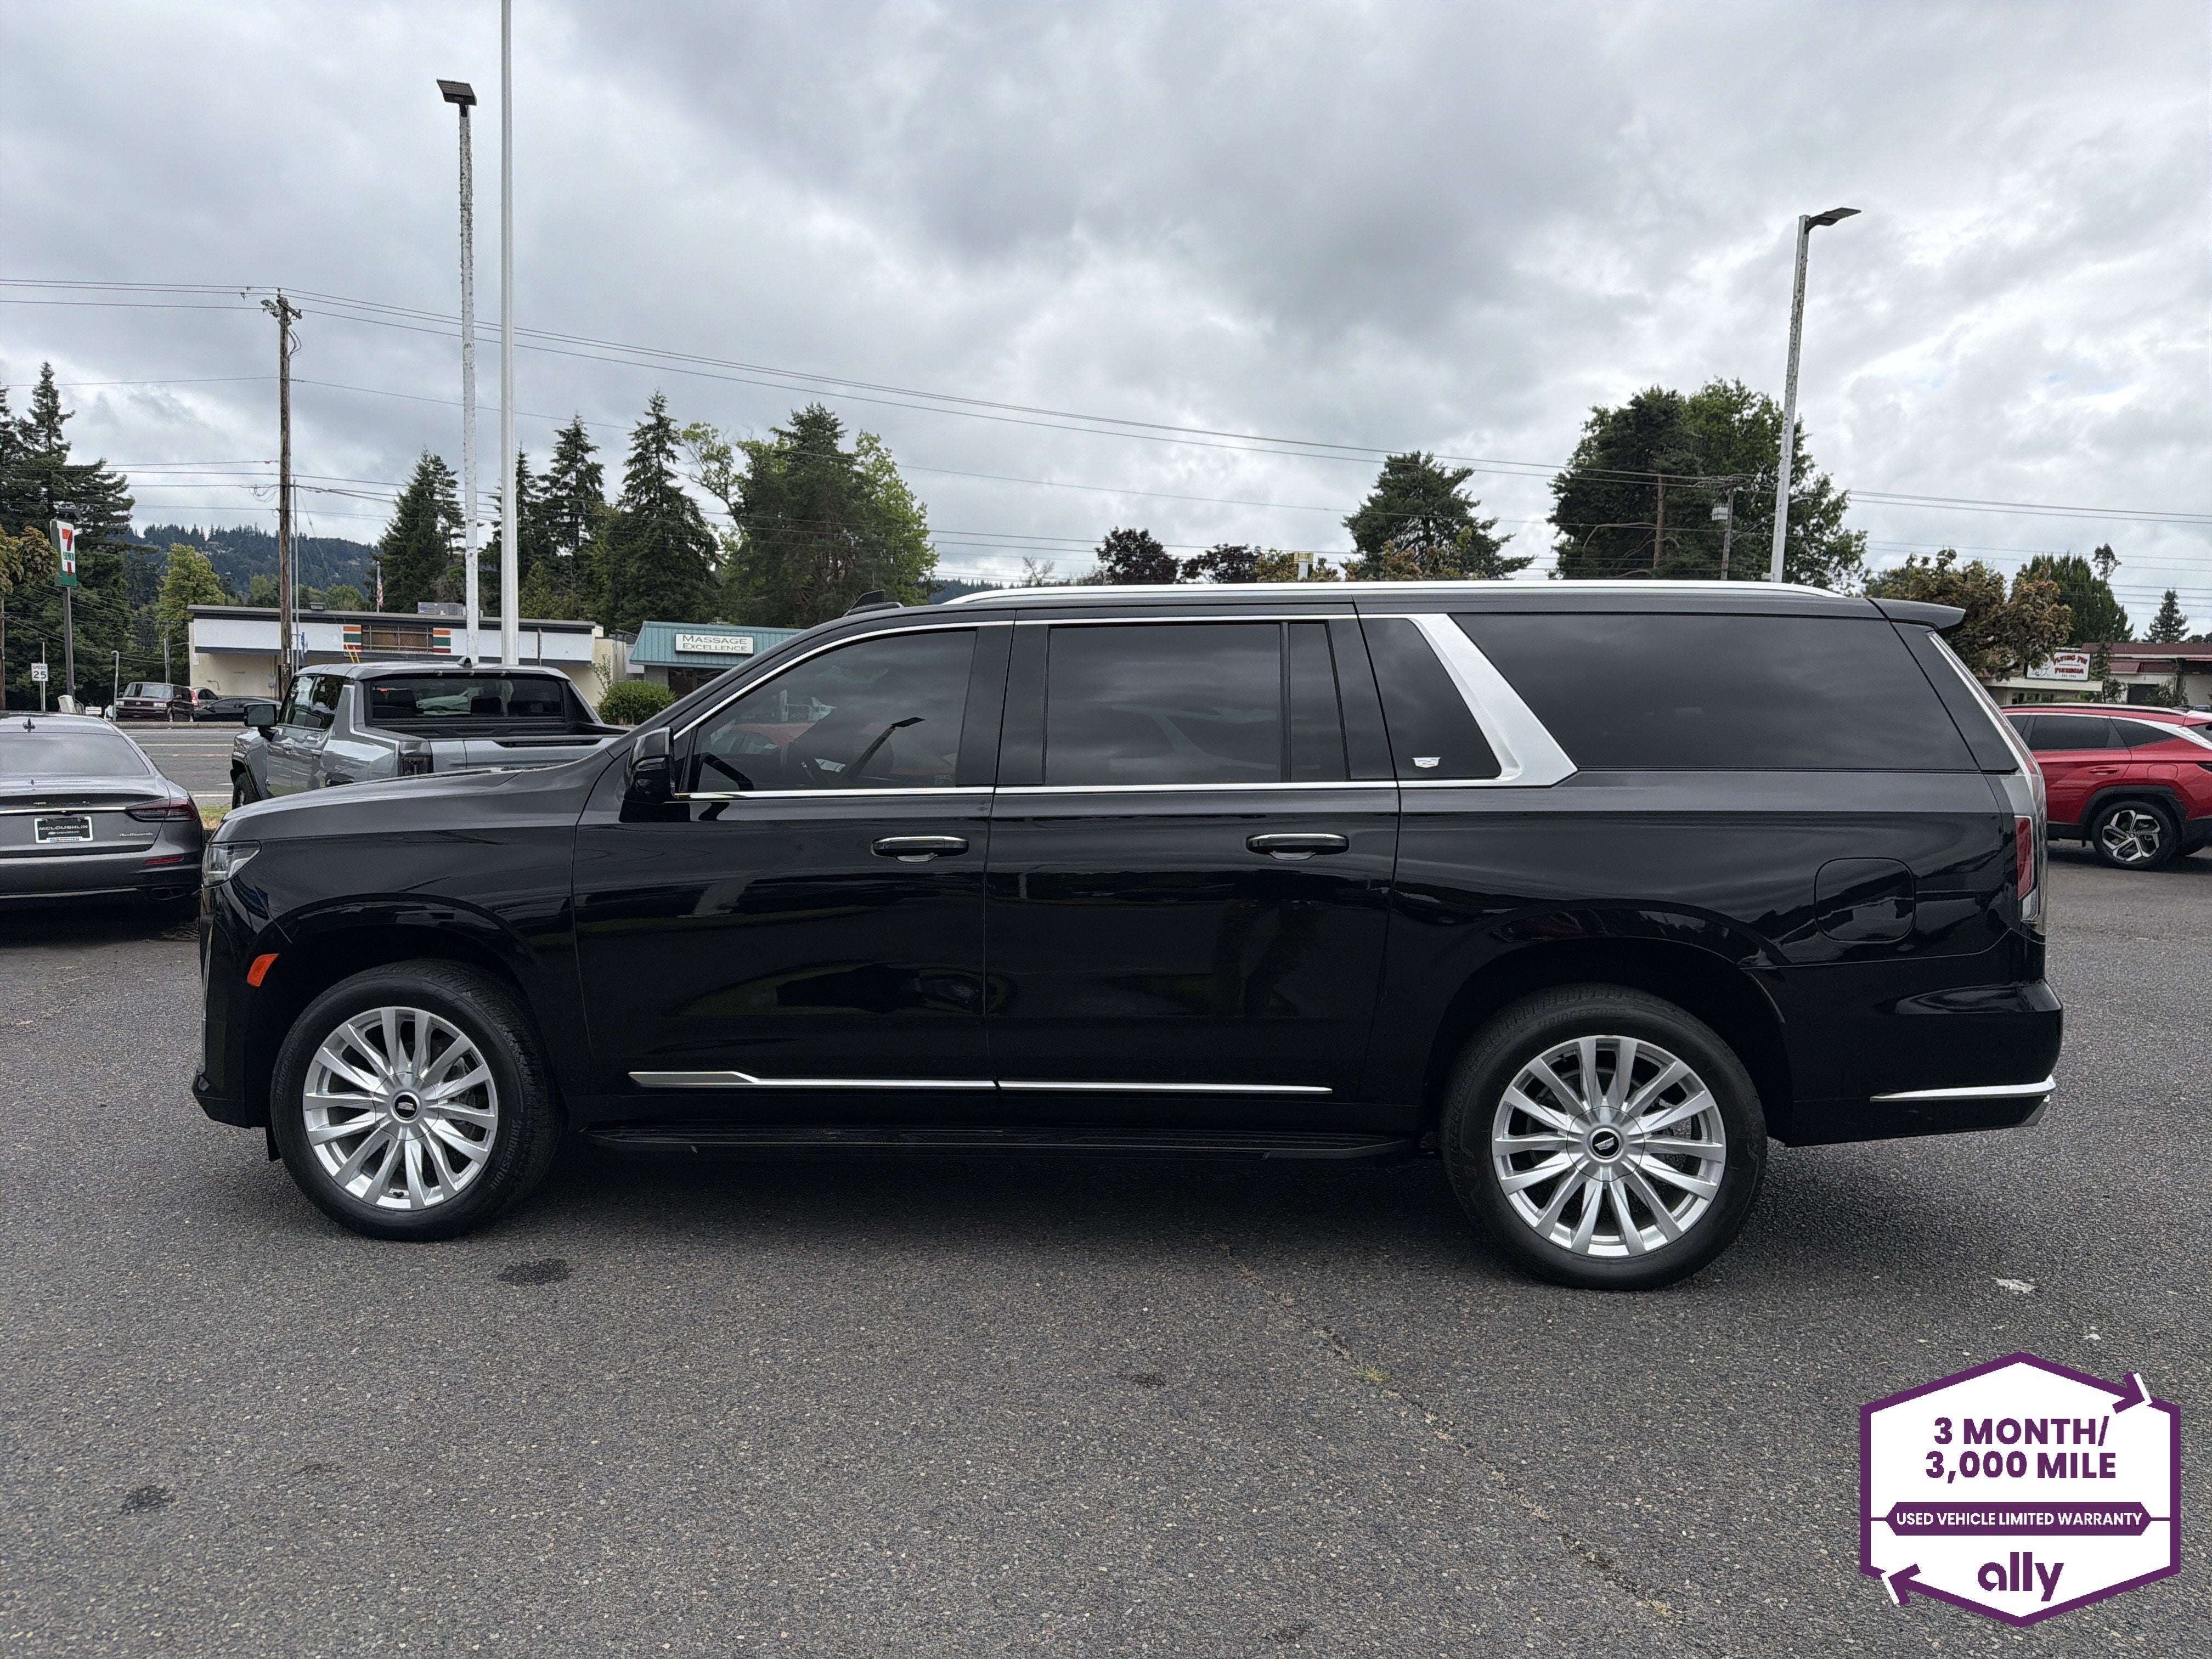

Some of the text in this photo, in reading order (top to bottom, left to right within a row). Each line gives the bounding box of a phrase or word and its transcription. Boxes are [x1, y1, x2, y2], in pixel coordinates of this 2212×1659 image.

[682, 635, 747, 645] MASSAGE
[682, 642, 747, 651] EXCELLENCE
[33, 670, 47, 679] 25
